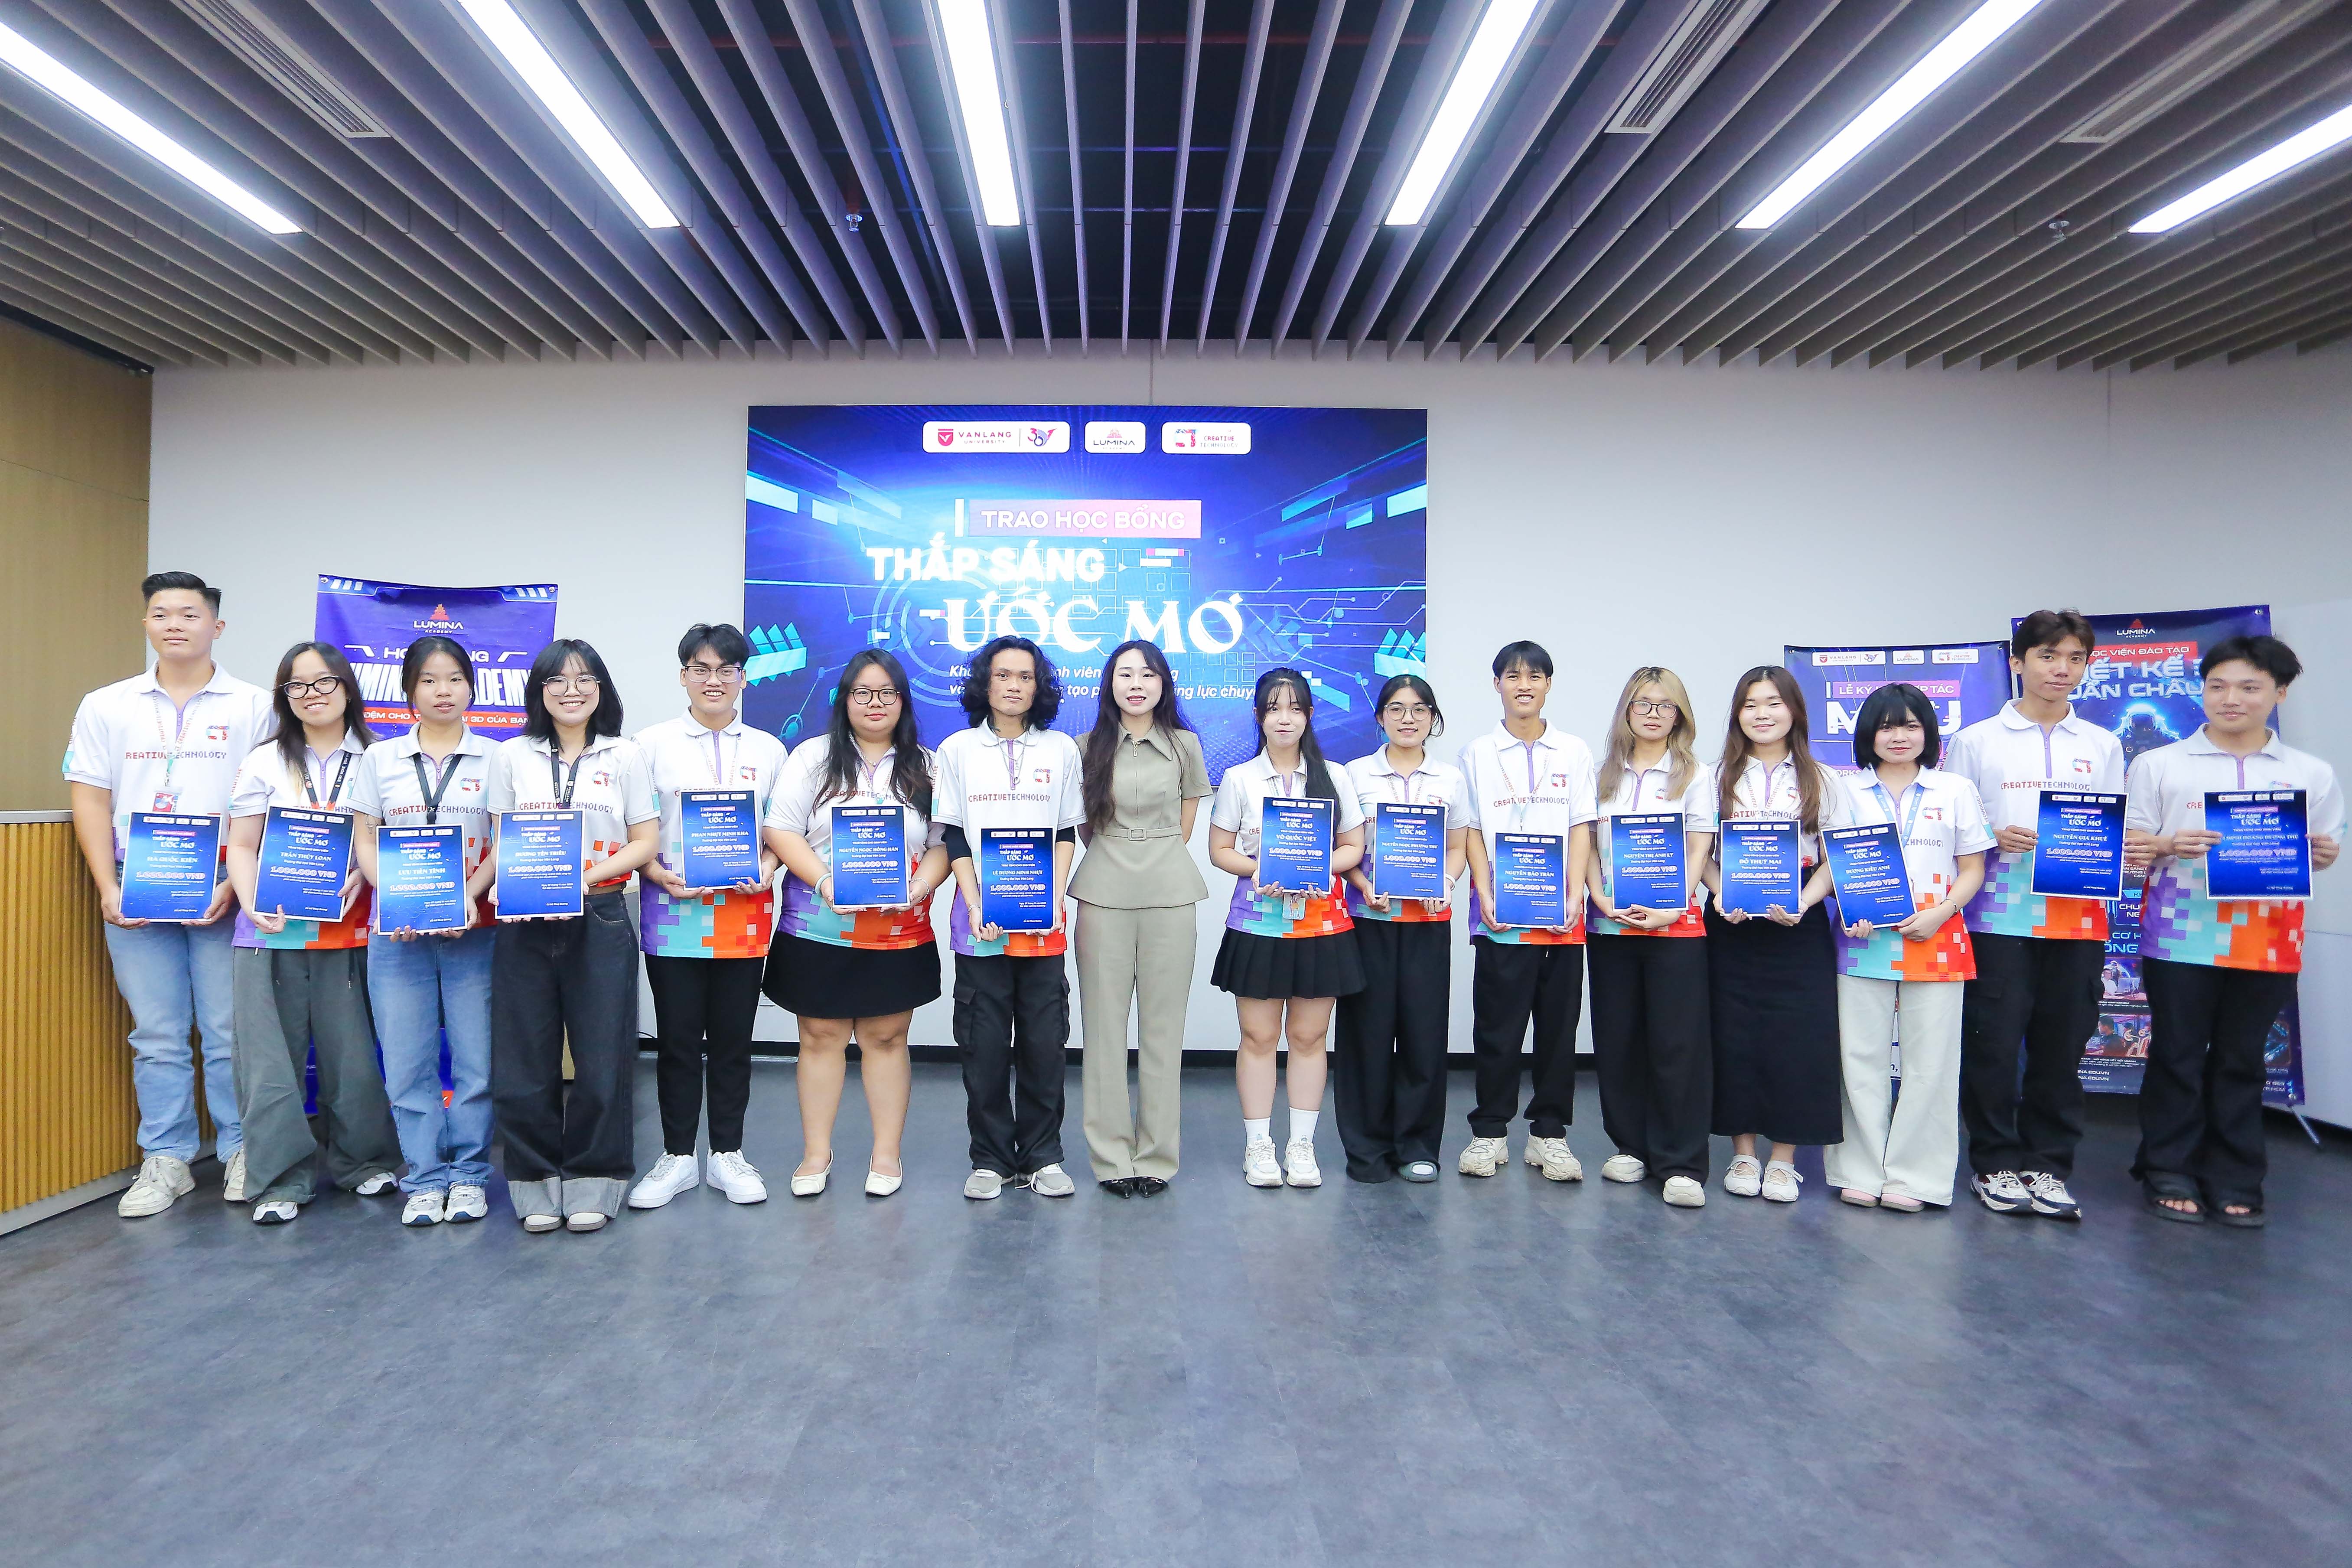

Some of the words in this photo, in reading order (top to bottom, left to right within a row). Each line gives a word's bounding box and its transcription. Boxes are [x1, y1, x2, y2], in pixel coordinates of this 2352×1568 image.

[981, 510, 1049, 529] TRAO
[1055, 510, 1108, 533] HỌC
[1114, 504, 1185, 529] BỔNG
[867, 532, 979, 581] THẮP
[990, 539, 1105, 582] SÁNG
[414, 620, 464, 629] LUMINA
[943, 586, 1102, 652] ƯỚC
[1124, 593, 1244, 654] MƠ
[2109, 649, 2136, 657] VIỆN
[1073, 666, 1101, 678] viên
[2141, 654, 2185, 678] KẾ
[1067, 686, 1088, 695] tạo
[1197, 685, 1217, 698] lực
[1839, 683, 1854, 694] LỄ
[1856, 683, 1873, 694] KÝ
[1930, 683, 1954, 694] TÁC
[487, 715, 508, 724] CỦA
[2046, 848, 2093, 856] 1.000.000
